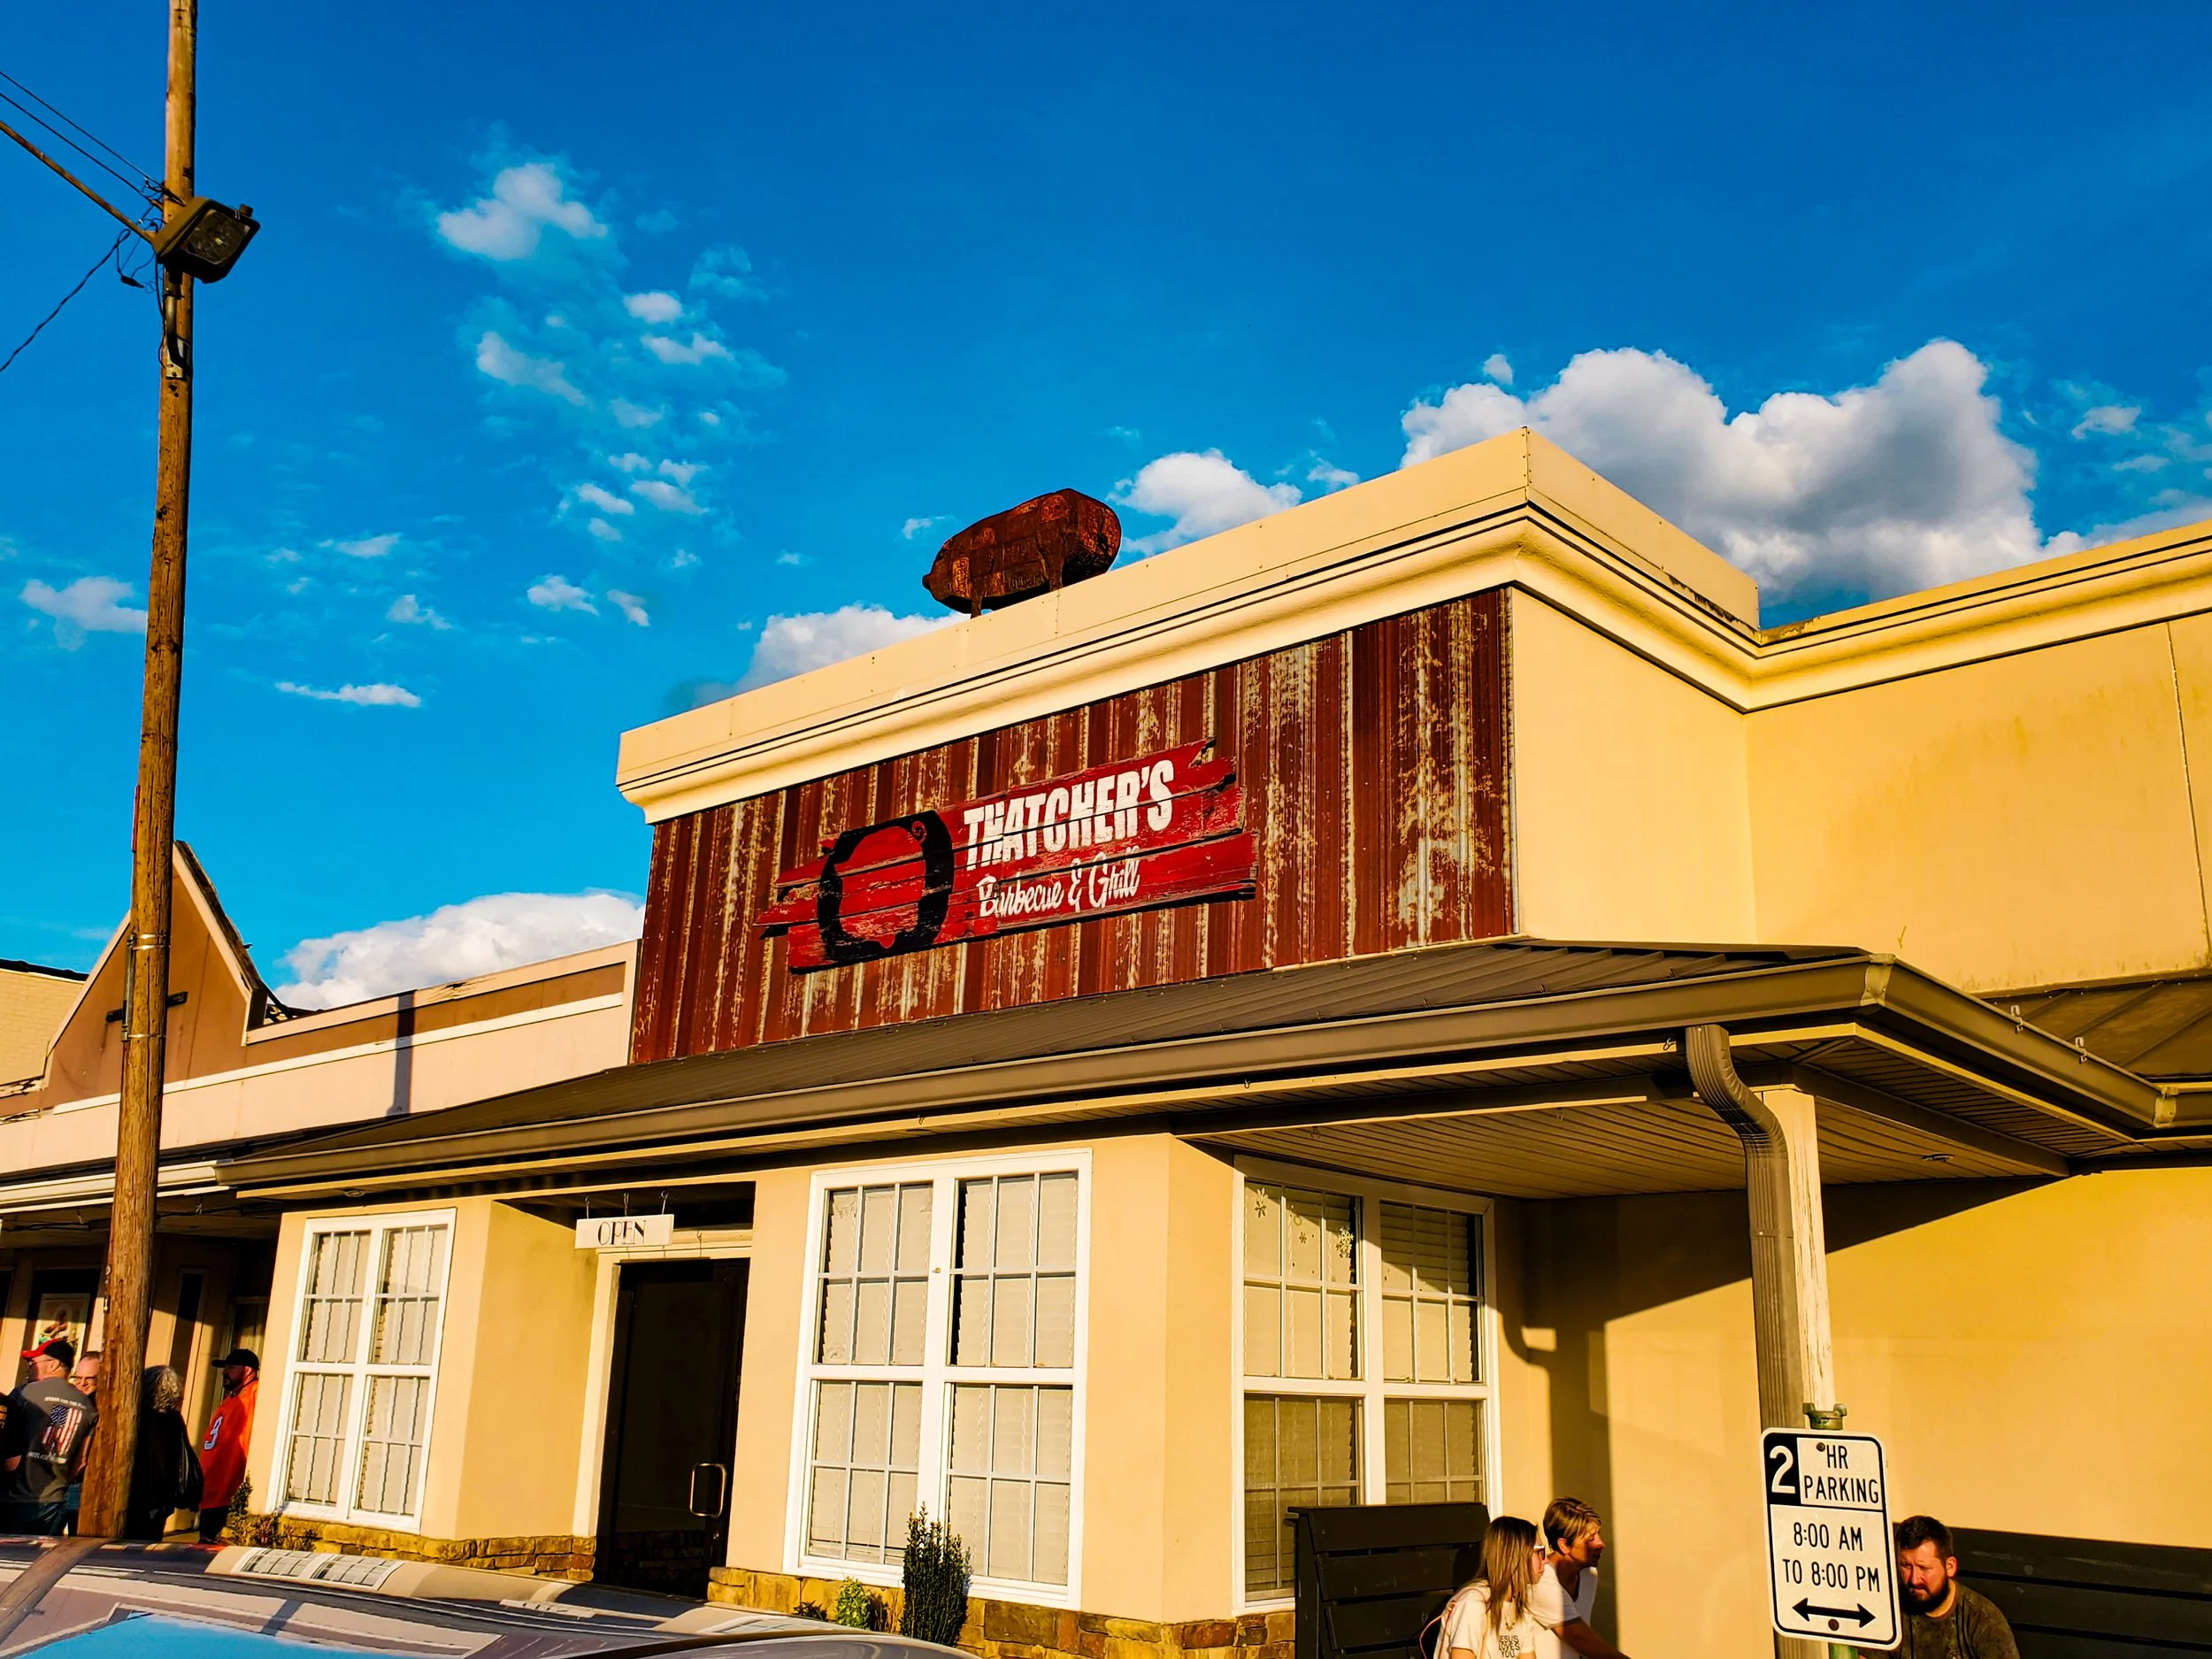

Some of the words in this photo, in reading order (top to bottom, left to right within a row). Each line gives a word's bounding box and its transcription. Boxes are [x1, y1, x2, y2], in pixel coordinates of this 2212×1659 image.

[964, 759, 1174, 872] THATCHER'S
[976, 872, 1064, 918] Barbecue
[1067, 857, 1082, 913] &
[1088, 845, 1141, 909] Grill
[597, 1220, 647, 1246] OPEN
[1769, 1445, 1796, 1494] 2
[1826, 1444, 1848, 1470] HR
[1803, 1475, 1879, 1504] PARKING
[1793, 1522, 1830, 1548] 8:00
[1839, 1525, 1863, 1552] AM
[1782, 1558, 1802, 1585] TO
[1811, 1561, 1848, 1589] 8:00
[1855, 1566, 1880, 1593] PM
[1497, 1634, 1519, 1643] ESUS
